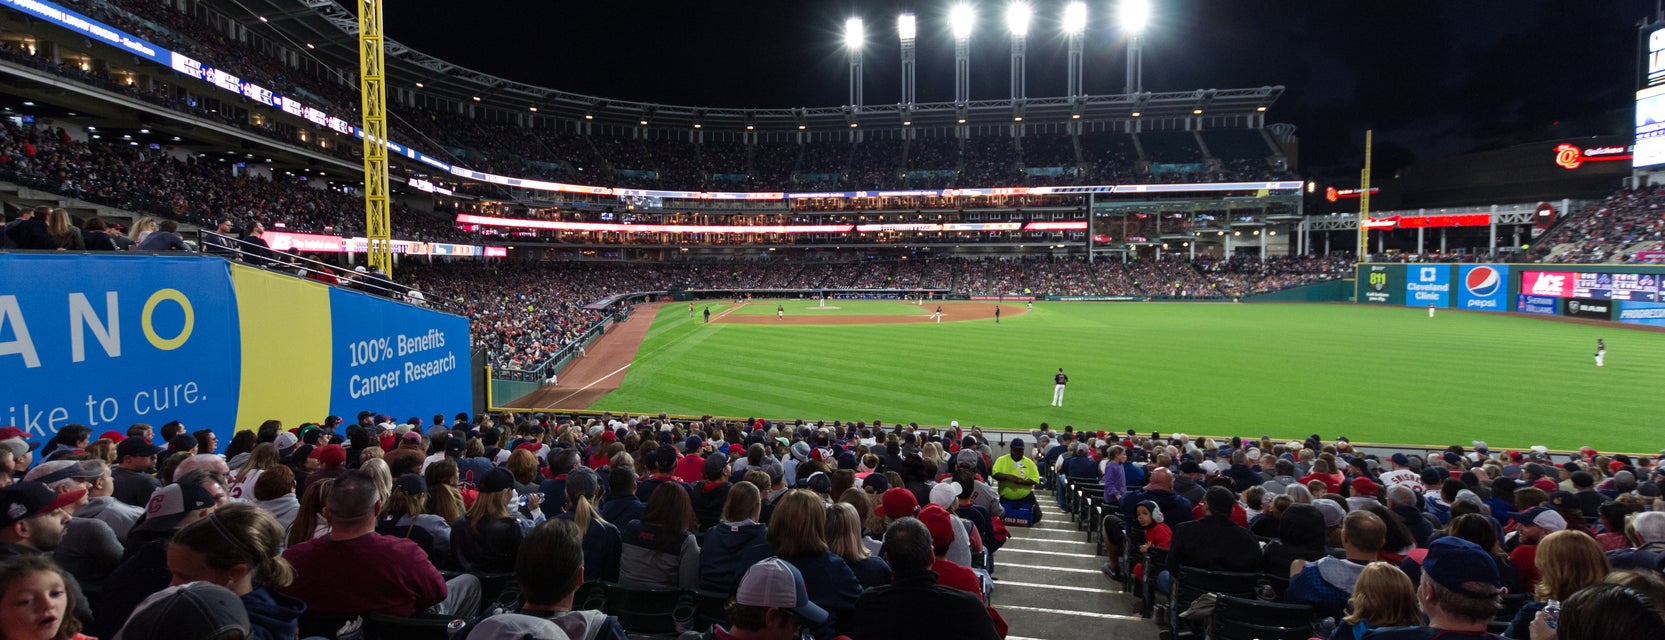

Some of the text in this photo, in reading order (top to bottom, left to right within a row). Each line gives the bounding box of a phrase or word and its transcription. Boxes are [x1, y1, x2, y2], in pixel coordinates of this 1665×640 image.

[1369, 272, 1386, 285] 811
[1532, 272, 1565, 292] ACE
[1407, 282, 1449, 292] Cleveland
[1415, 291, 1439, 300] Clinic
[1467, 299, 1497, 307] pepsi
[349, 329, 445, 367] 100% Benefits
[349, 351, 456, 399] Cancer Research
[0, 381, 207, 438] ike to cure.
